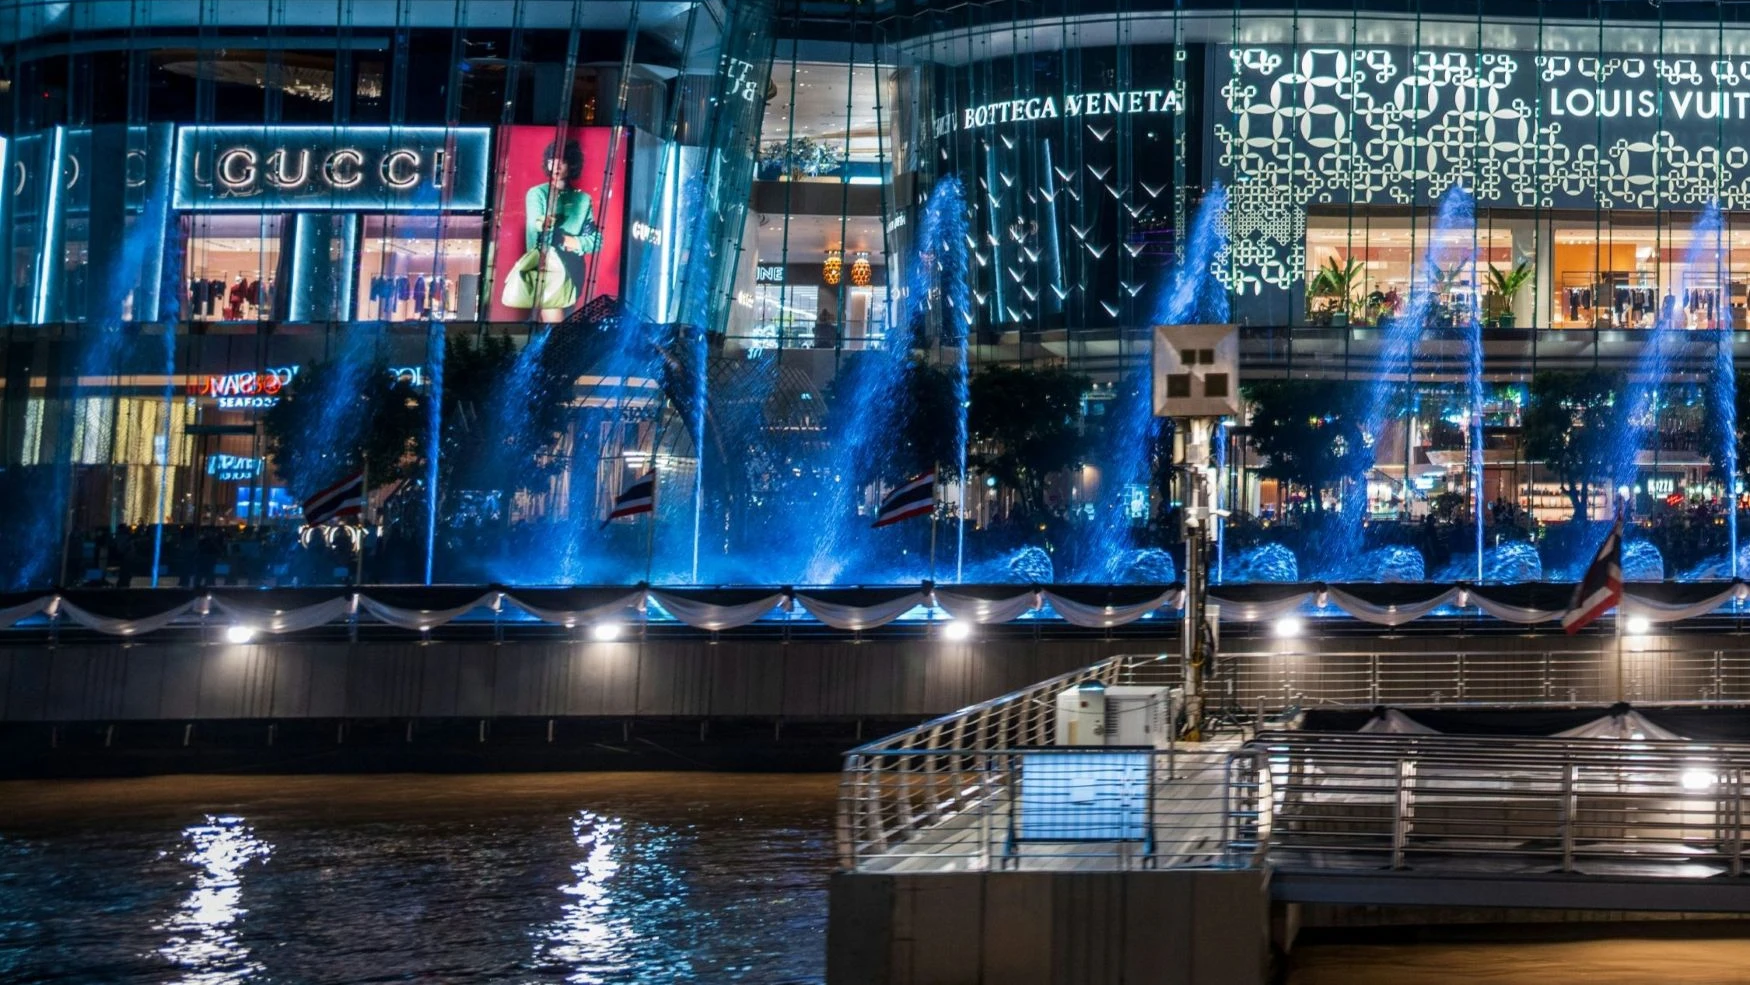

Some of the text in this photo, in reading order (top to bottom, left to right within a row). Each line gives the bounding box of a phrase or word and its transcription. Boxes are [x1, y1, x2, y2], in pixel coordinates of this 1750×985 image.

[963, 96, 1058, 130] BOTTEGA
[1067, 89, 1176, 118] VENETA
[1550, 87, 1656, 118] LOUIS
[217, 148, 446, 189] GUCCI
